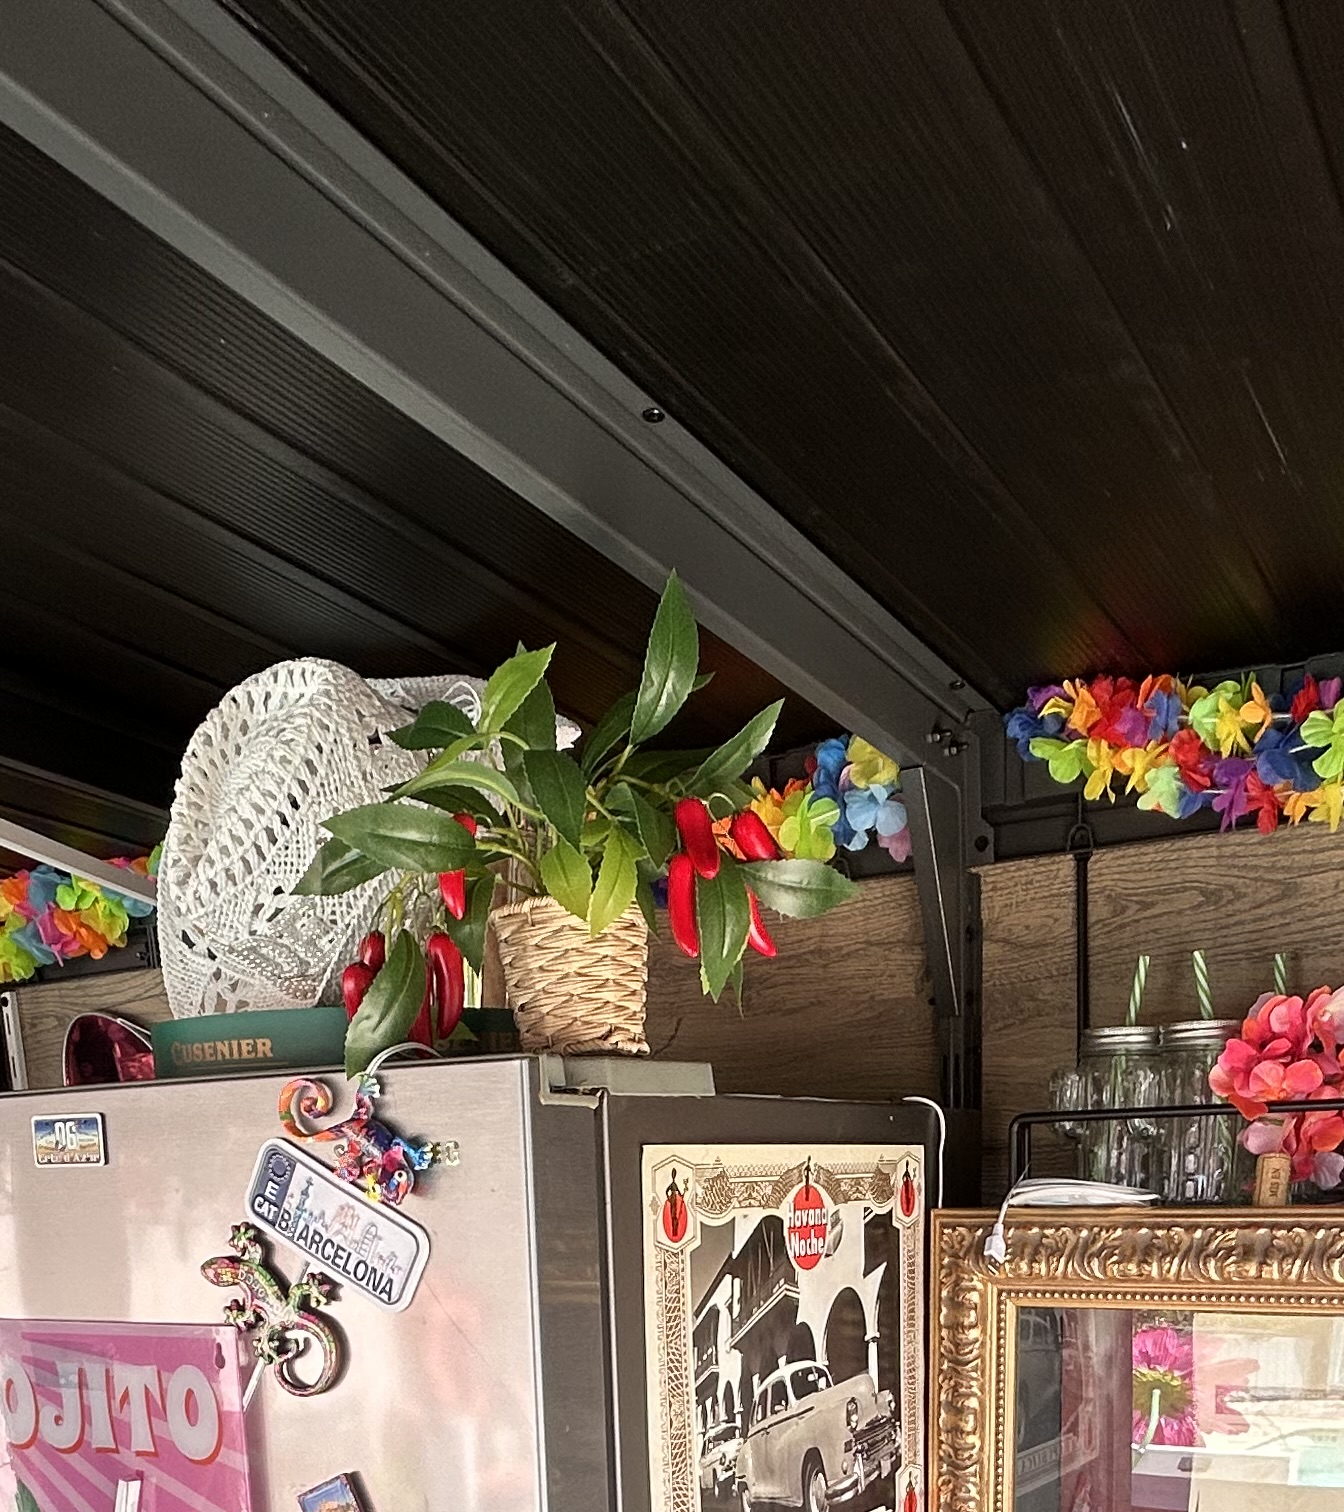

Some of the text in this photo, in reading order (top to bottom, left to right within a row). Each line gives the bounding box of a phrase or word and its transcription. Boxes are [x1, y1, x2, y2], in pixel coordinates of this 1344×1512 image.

[172, 1037, 274, 1066] CUSENIER
[54, 1121, 78, 1150] 06
[264, 1179, 280, 1200] E
[253, 1195, 279, 1220] CAT
[787, 1201, 828, 1228] Havana
[277, 1208, 394, 1302] BARCELONA
[790, 1229, 824, 1258] Noche
